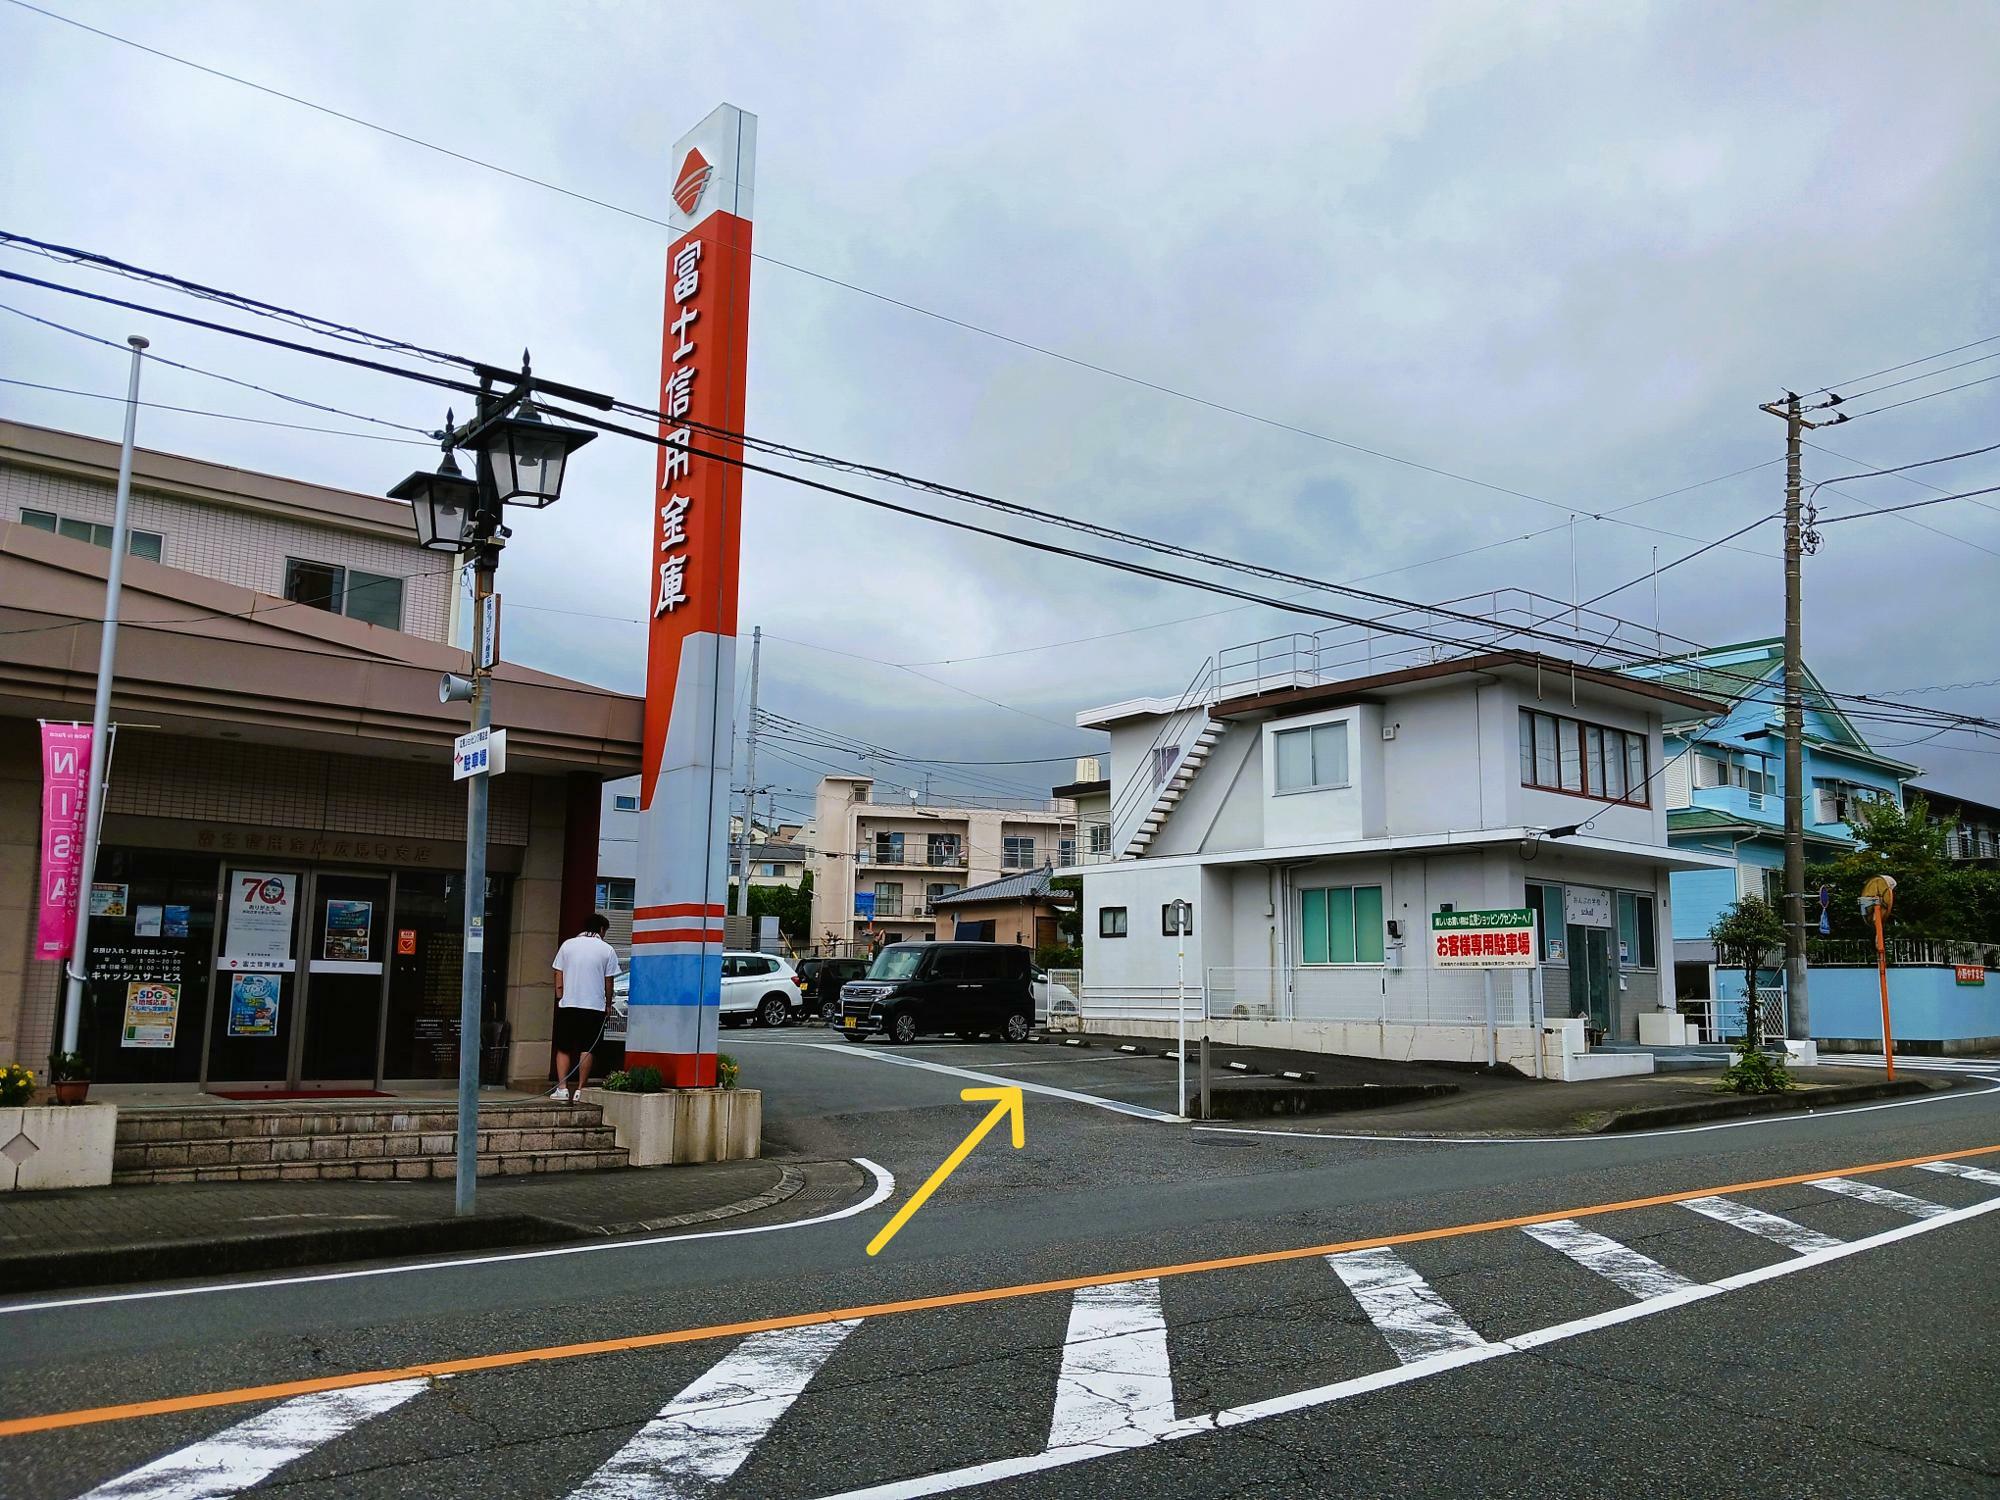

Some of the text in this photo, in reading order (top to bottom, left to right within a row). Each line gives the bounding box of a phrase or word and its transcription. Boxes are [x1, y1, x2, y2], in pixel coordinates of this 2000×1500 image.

[654, 241, 703, 620] 富士信用金庫
[463, 748, 487, 772] 駐車場
[241, 877, 285, 904] 70
[1436, 932, 1530, 956] お客様専用駐車場
[91, 971, 182, 982] キャッシュサービス
